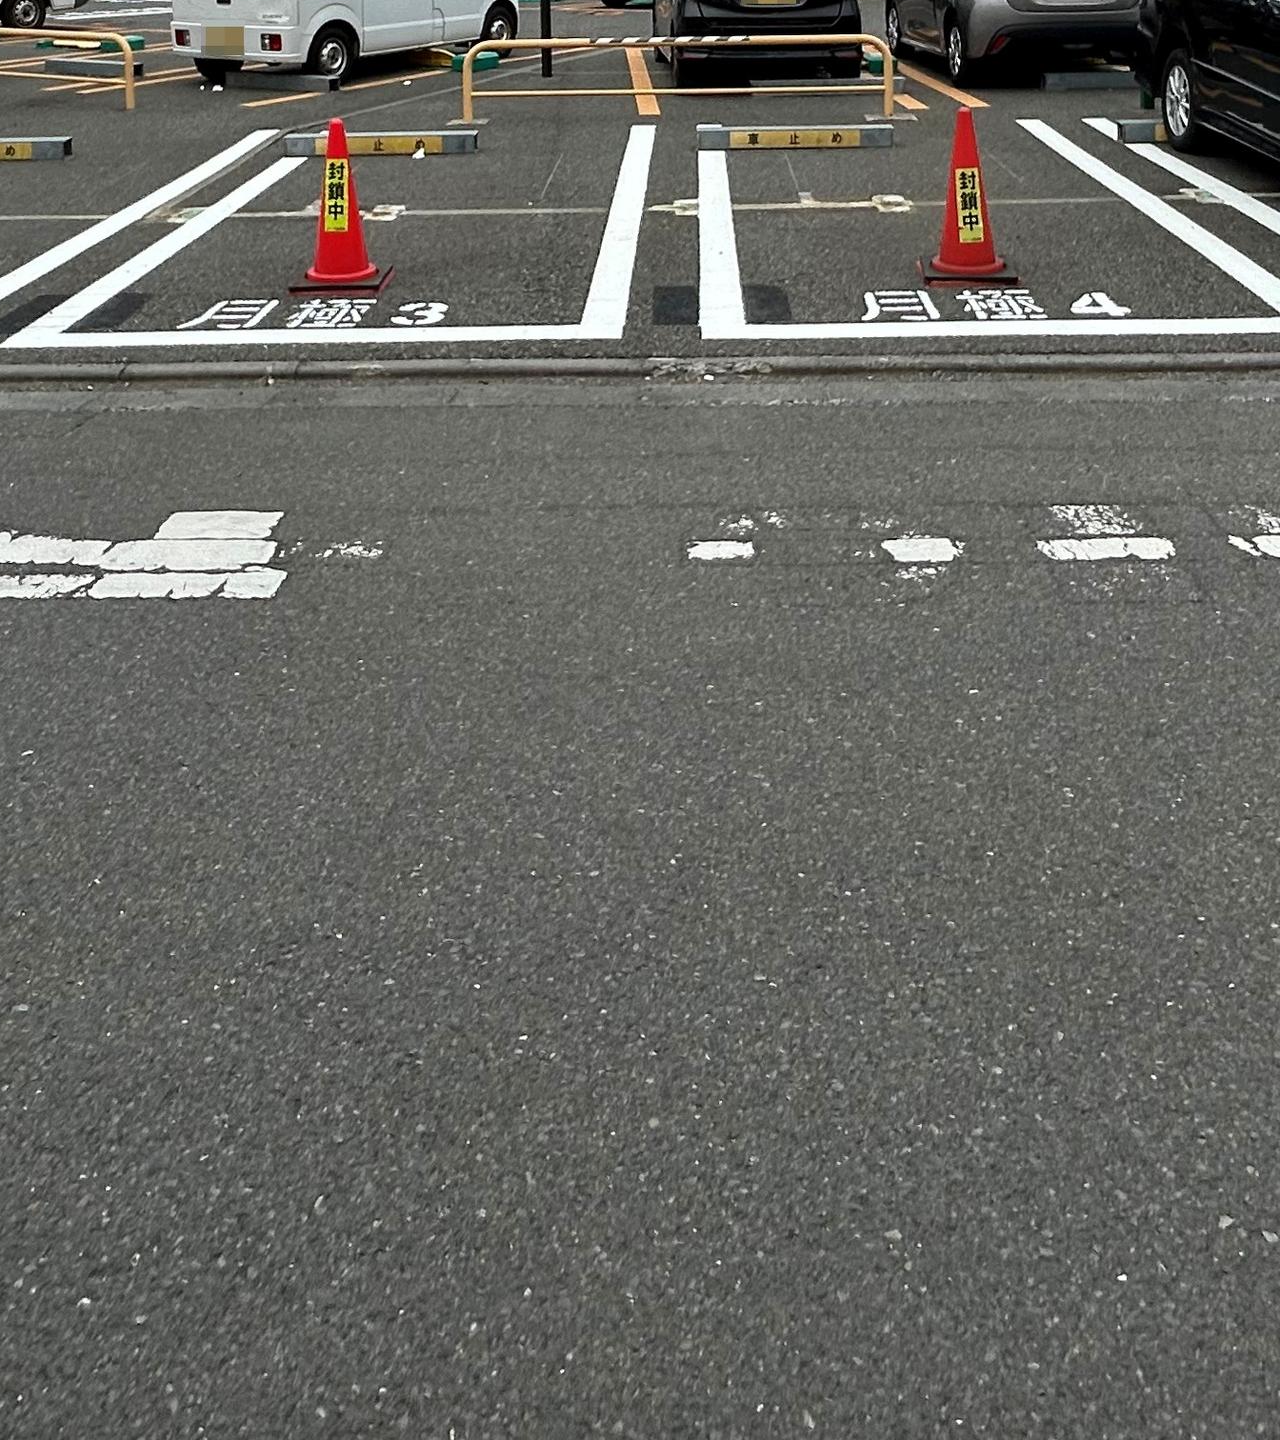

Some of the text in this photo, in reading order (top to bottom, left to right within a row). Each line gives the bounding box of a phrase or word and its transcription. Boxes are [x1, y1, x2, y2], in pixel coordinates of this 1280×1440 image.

[328, 162, 345, 221] 封鎖中
[959, 171, 979, 231] 封鎖中
